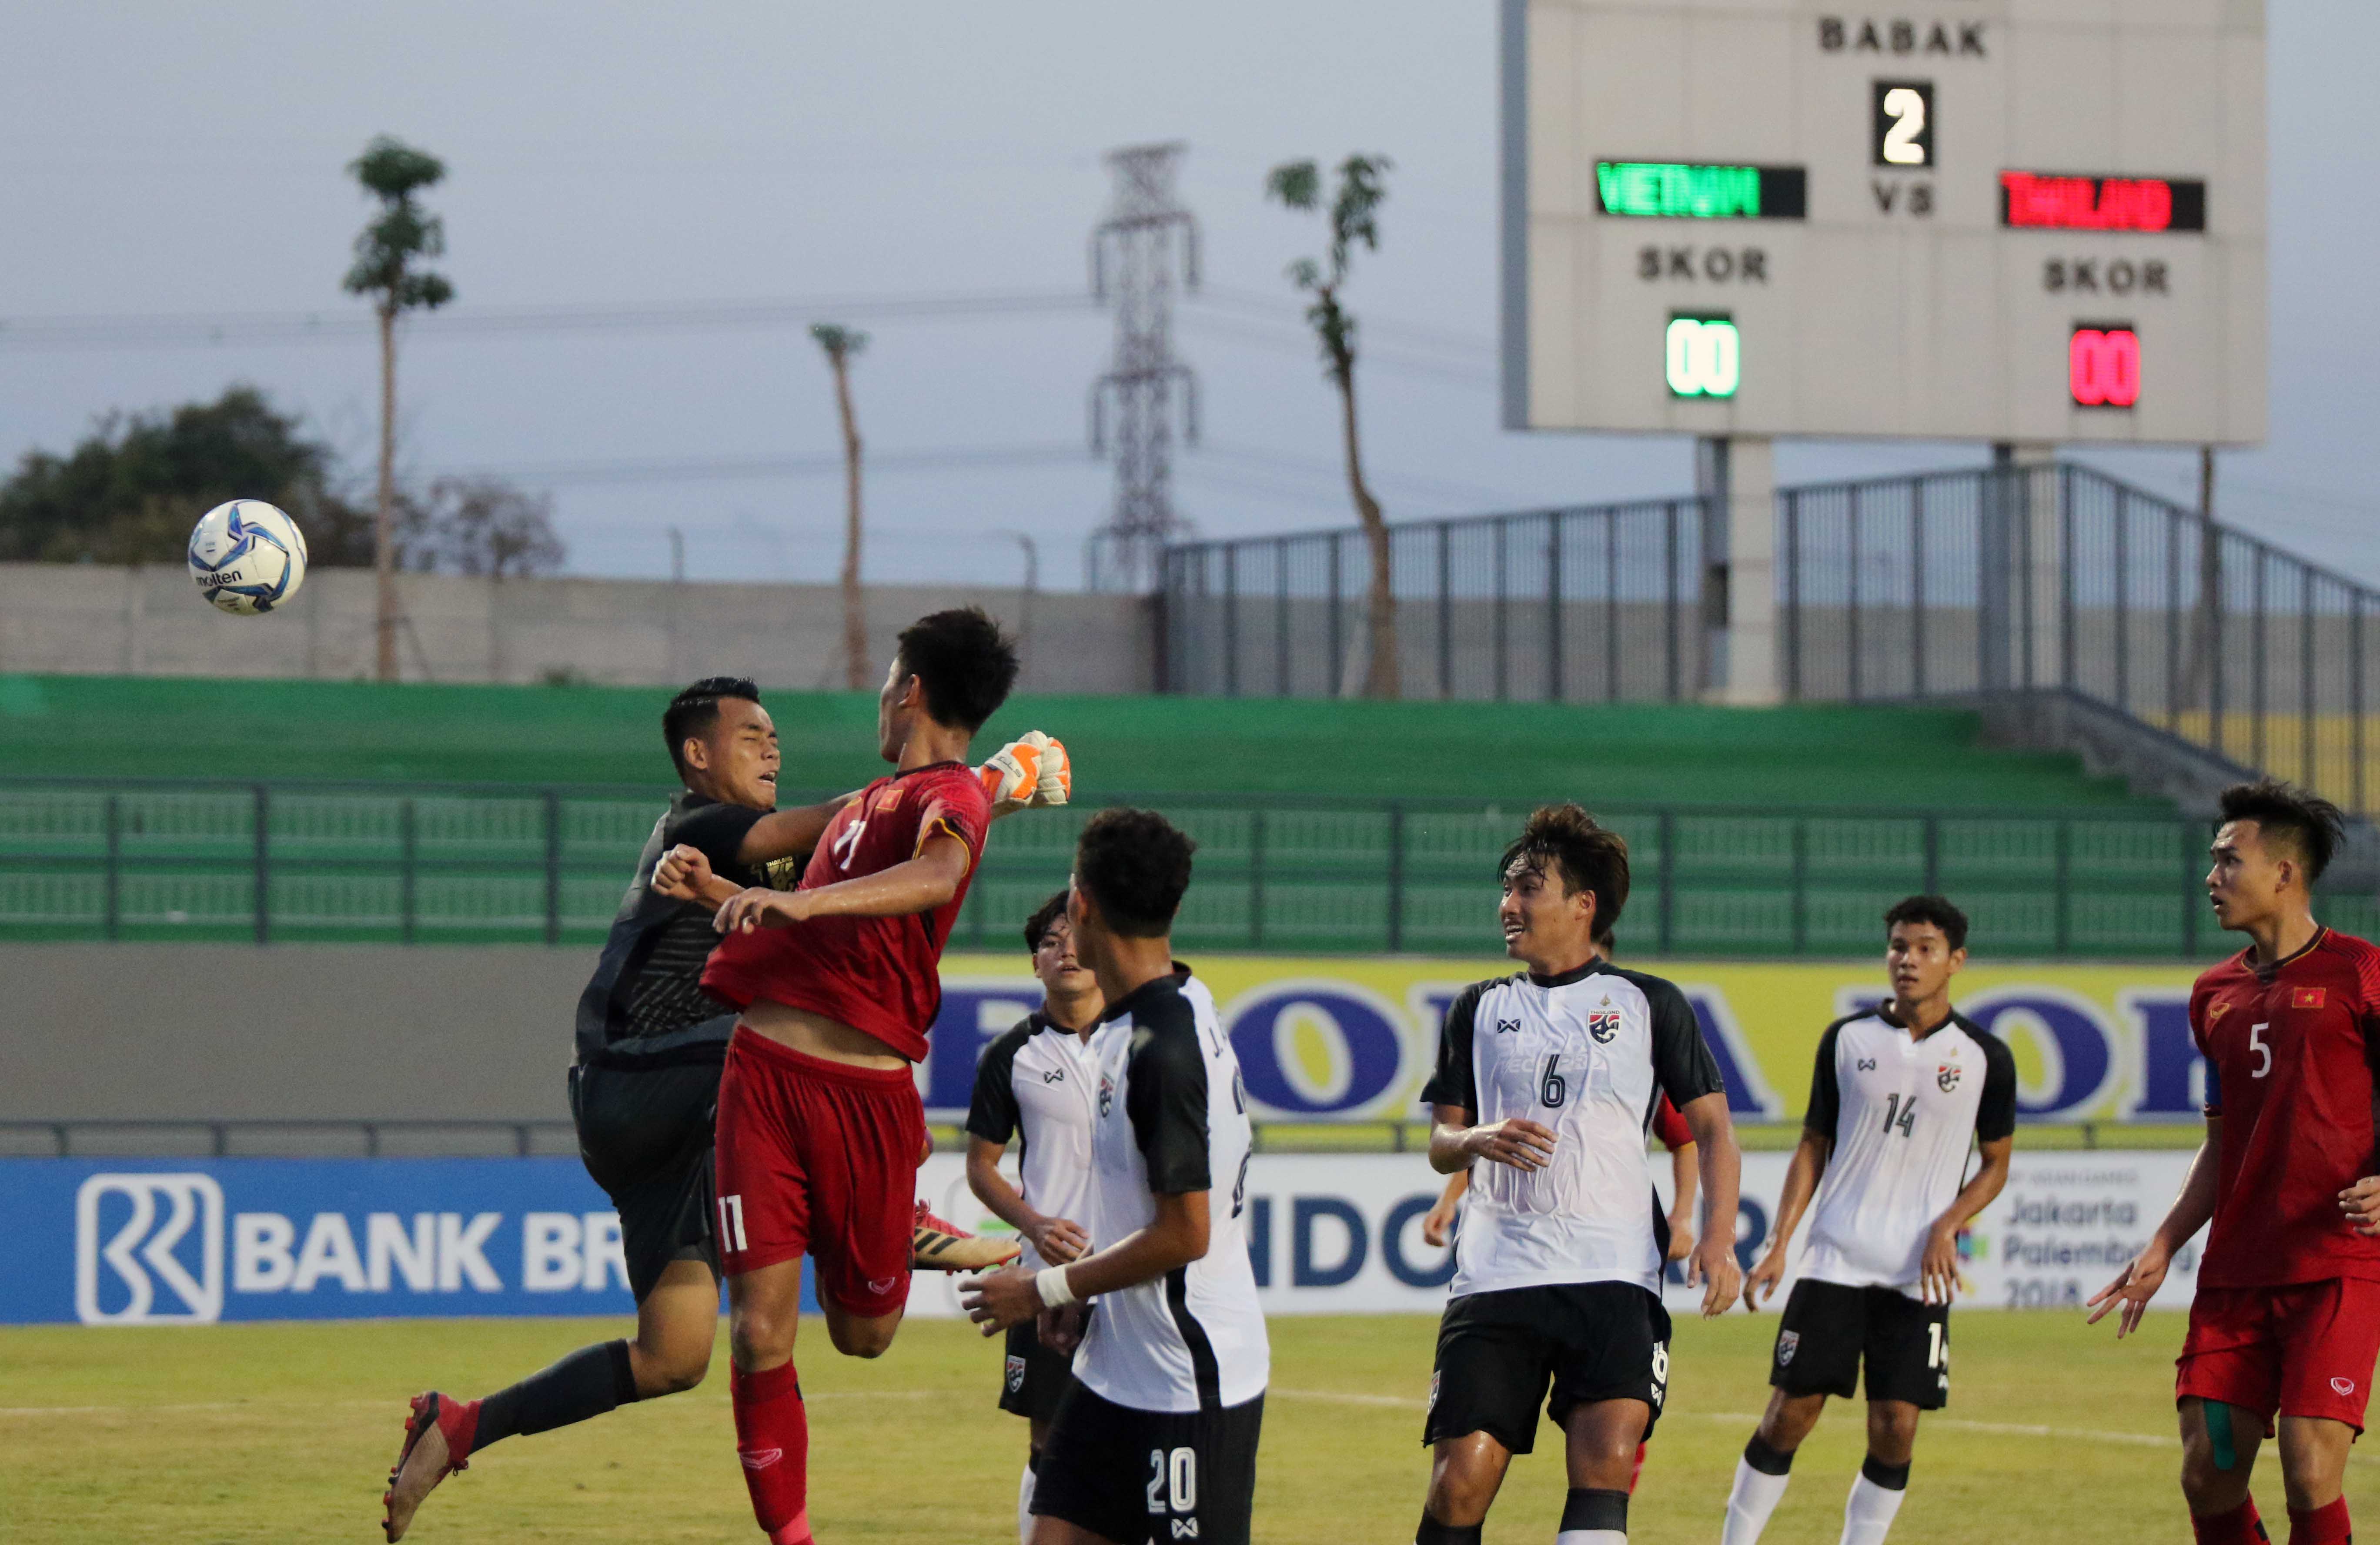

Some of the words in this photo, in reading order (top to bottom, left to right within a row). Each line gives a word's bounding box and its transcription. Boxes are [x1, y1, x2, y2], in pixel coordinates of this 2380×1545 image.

[1819, 17, 1989, 57] BABAK
[1883, 88, 1925, 164] 2
[1597, 163, 1762, 217] VIETNAM
[1872, 184, 1935, 216] VS
[2000, 171, 2172, 231] THAILAND
[1639, 246, 1769, 283] SKOR
[2044, 258, 2170, 294] SKOR
[1666, 318, 1739, 396] 00
[2070, 329, 2140, 406] 00
[196, 570, 243, 587] molten
[2250, 1022, 2272, 1078] 5
[1541, 1053, 1566, 1108] 6
[1882, 1093, 1917, 1137] 14
[718, 1194, 748, 1253] 11
[2005, 1194, 2136, 1225] Jakarta
[234, 1213, 503, 1292] BANK
[2005, 1236, 2193, 1273] Palembg
[2006, 1279, 2081, 1307] 2018
[1652, 1340, 1668, 1384] 6
[1147, 1447, 1197, 1513] 20
